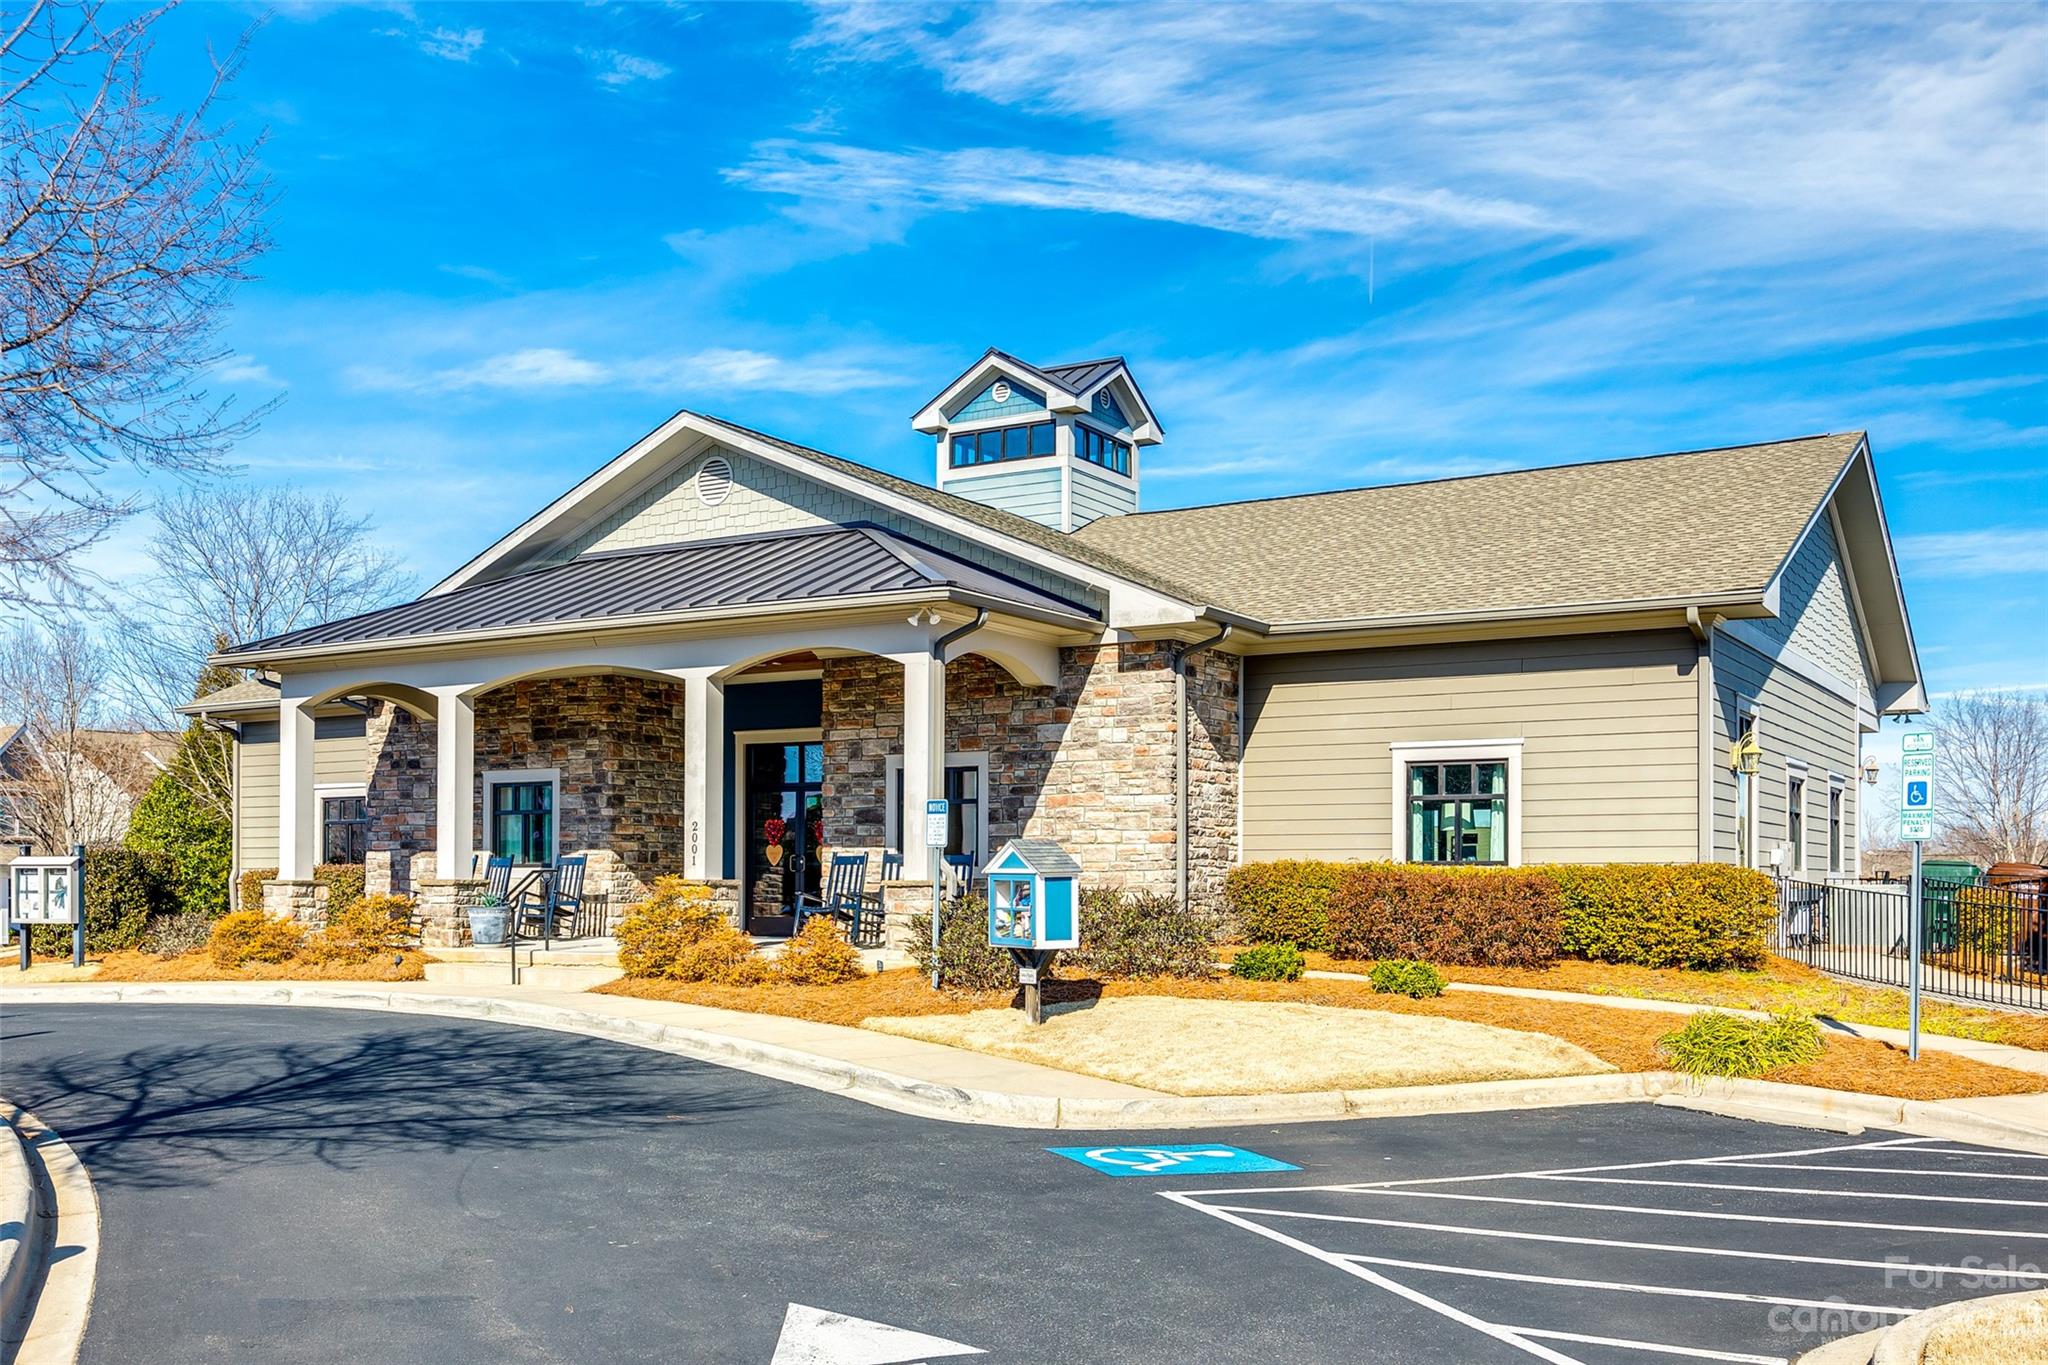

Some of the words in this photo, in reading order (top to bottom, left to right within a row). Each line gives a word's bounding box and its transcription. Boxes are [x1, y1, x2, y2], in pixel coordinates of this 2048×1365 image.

[1904, 758, 1932, 767] RESERVED
[1905, 768, 1931, 776] PARKING
[691, 821, 699, 866] 2001
